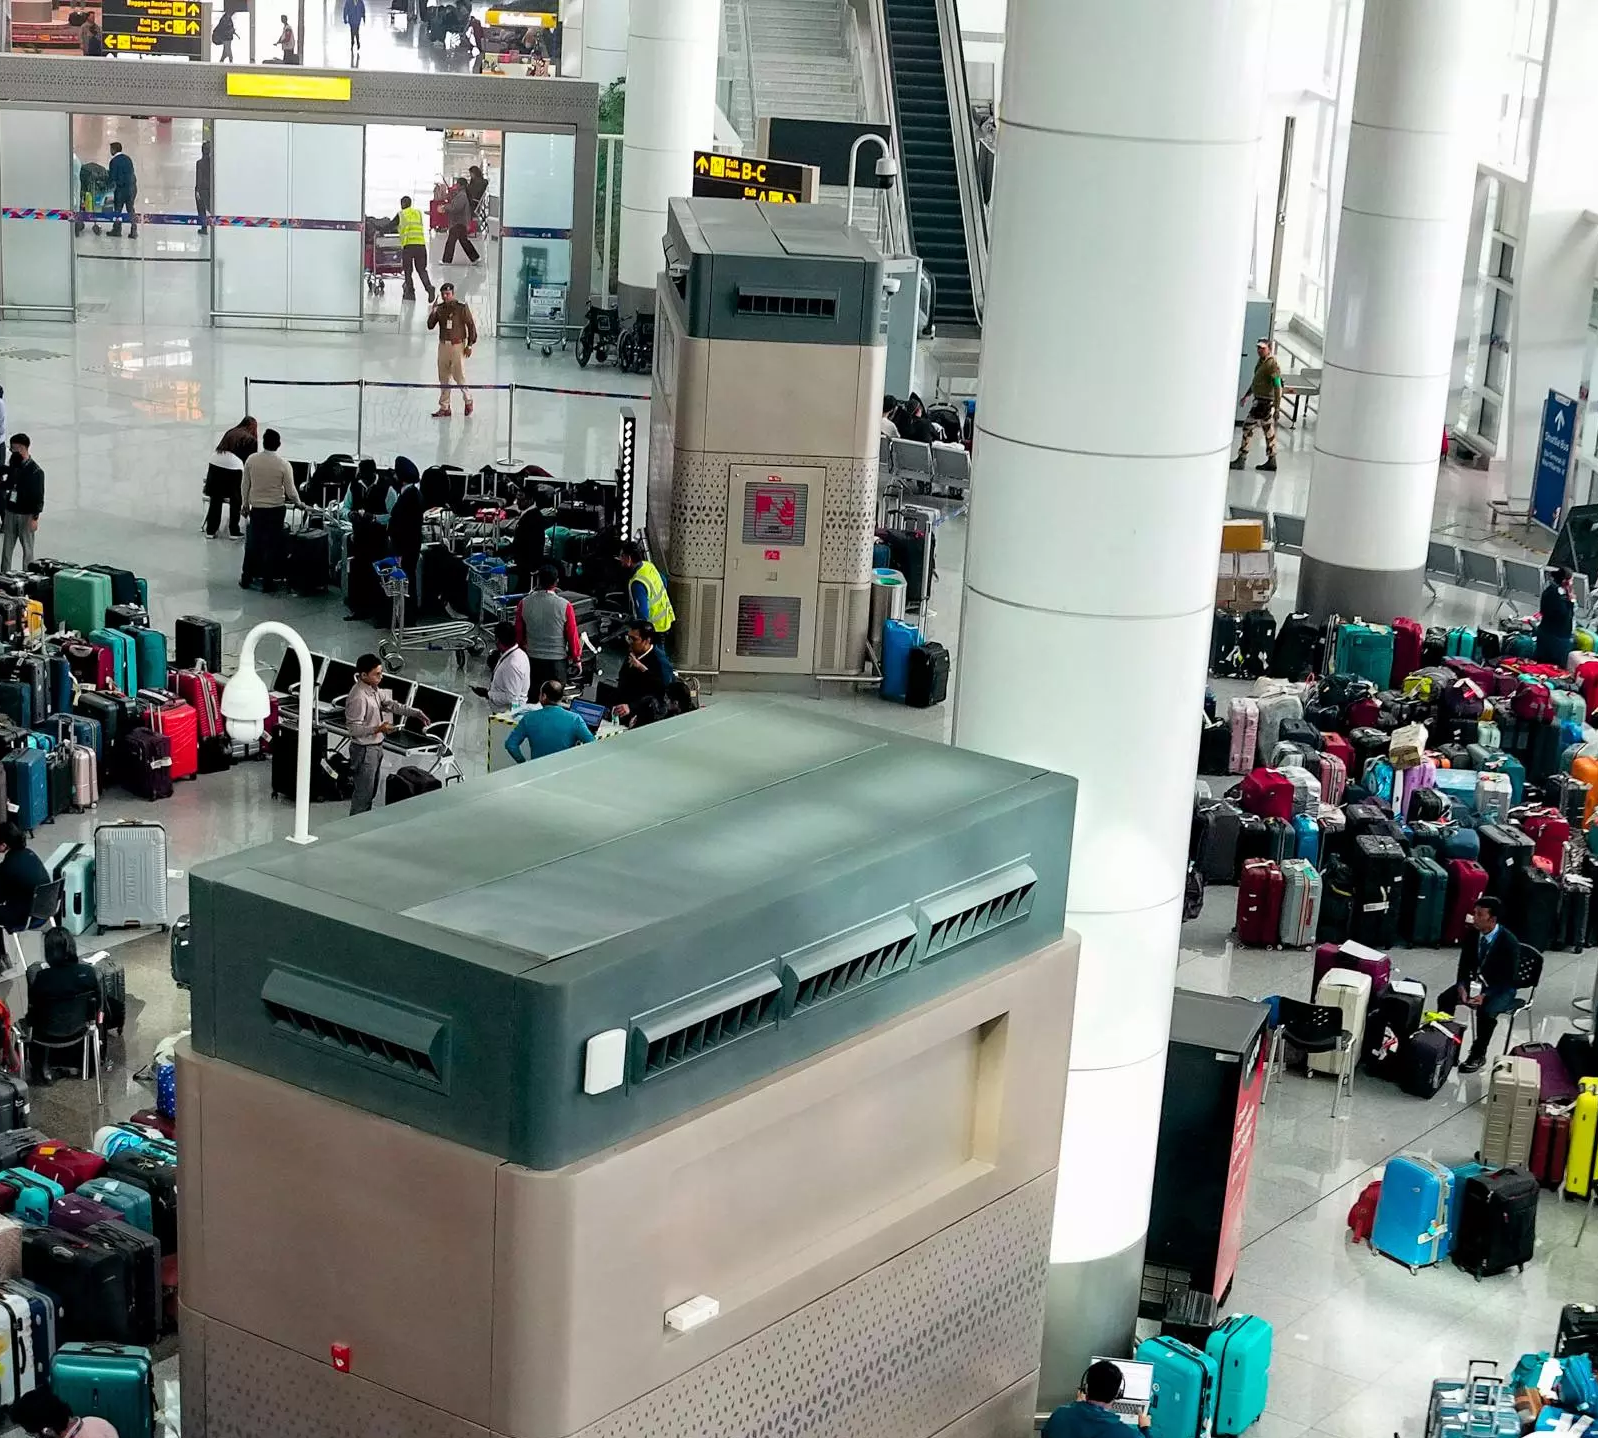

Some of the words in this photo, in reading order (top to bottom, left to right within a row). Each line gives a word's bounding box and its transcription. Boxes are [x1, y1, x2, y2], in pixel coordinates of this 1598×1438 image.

[151, 20, 173, 32] B-C
[726, 158, 739, 169] Exit
[742, 162, 767, 182] B-C
[744, 187, 757, 197] Exit
